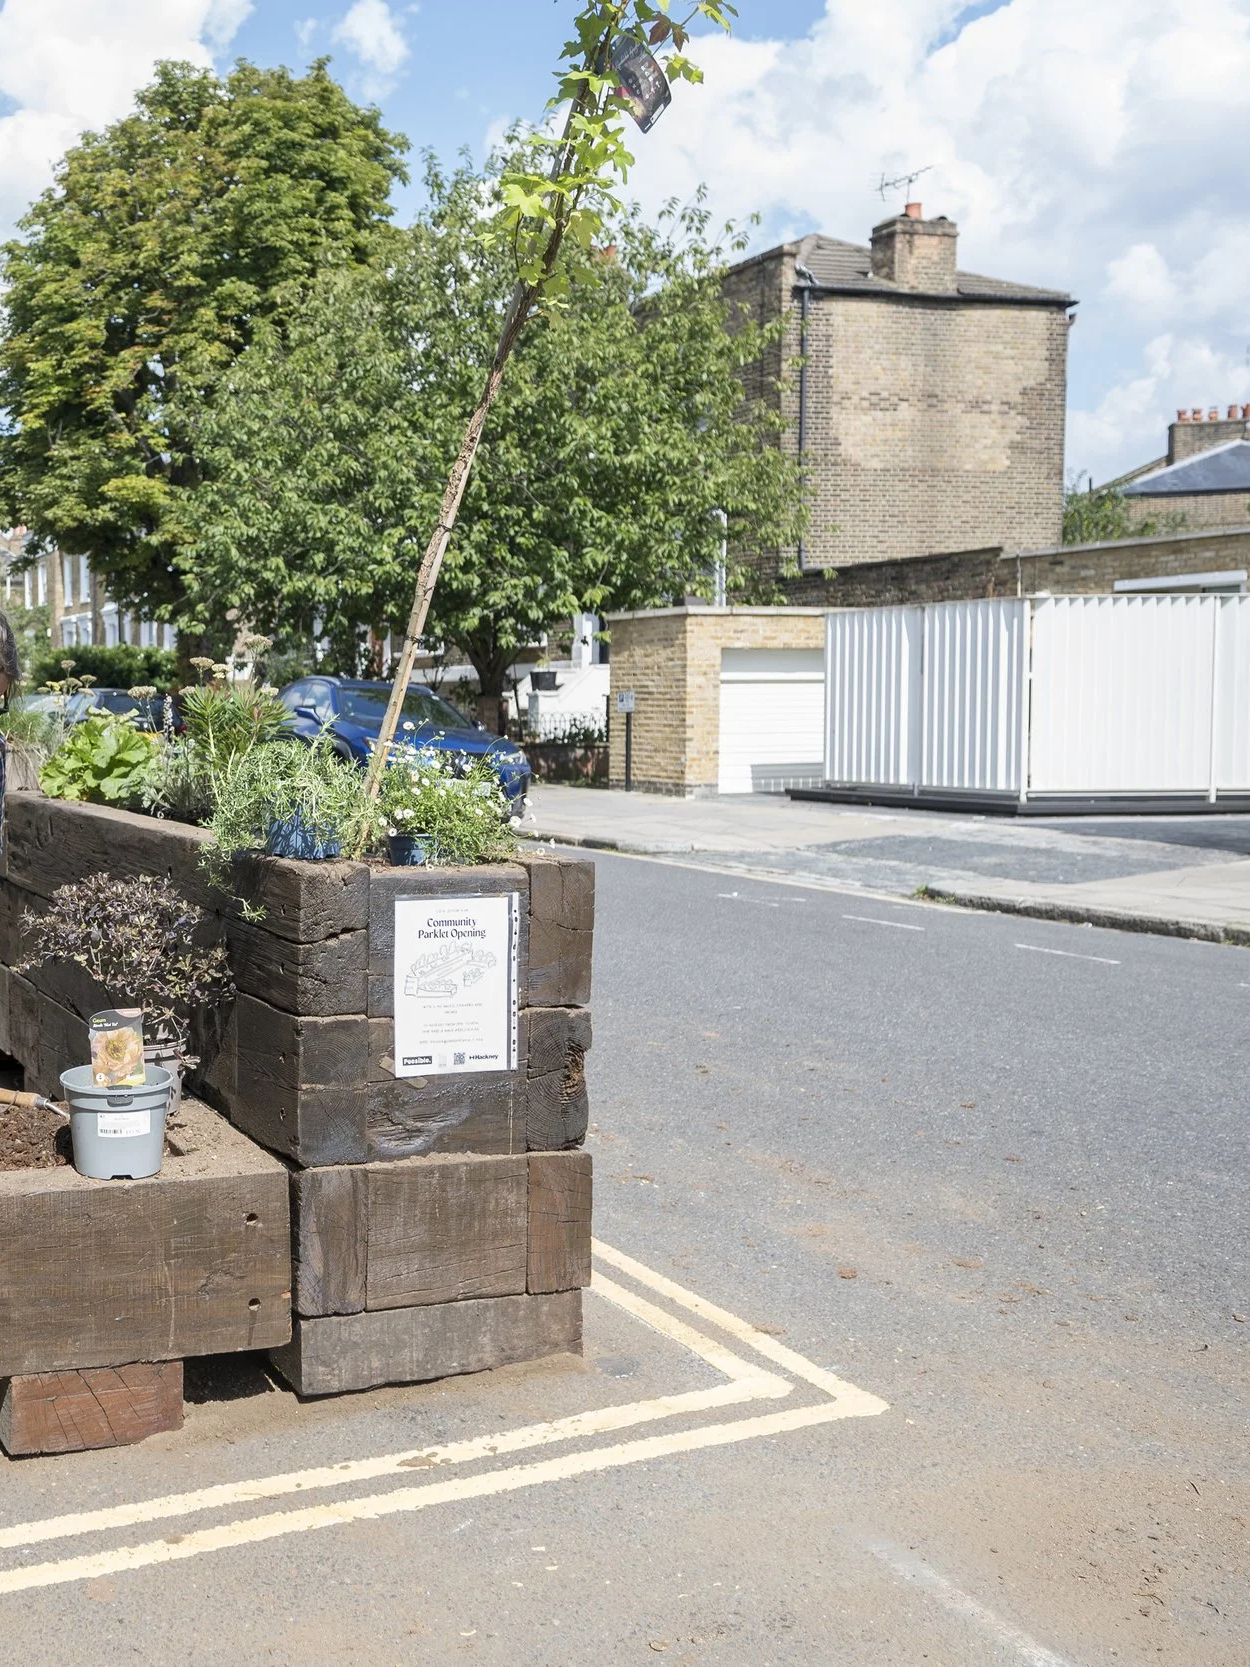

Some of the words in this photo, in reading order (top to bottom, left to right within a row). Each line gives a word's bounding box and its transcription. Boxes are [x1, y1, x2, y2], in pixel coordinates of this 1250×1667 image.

[427, 917, 477, 928] Community
[418, 929, 449, 939] Parklet
[450, 928, 486, 939] Opening
[473, 1053, 499, 1061] Hackney
